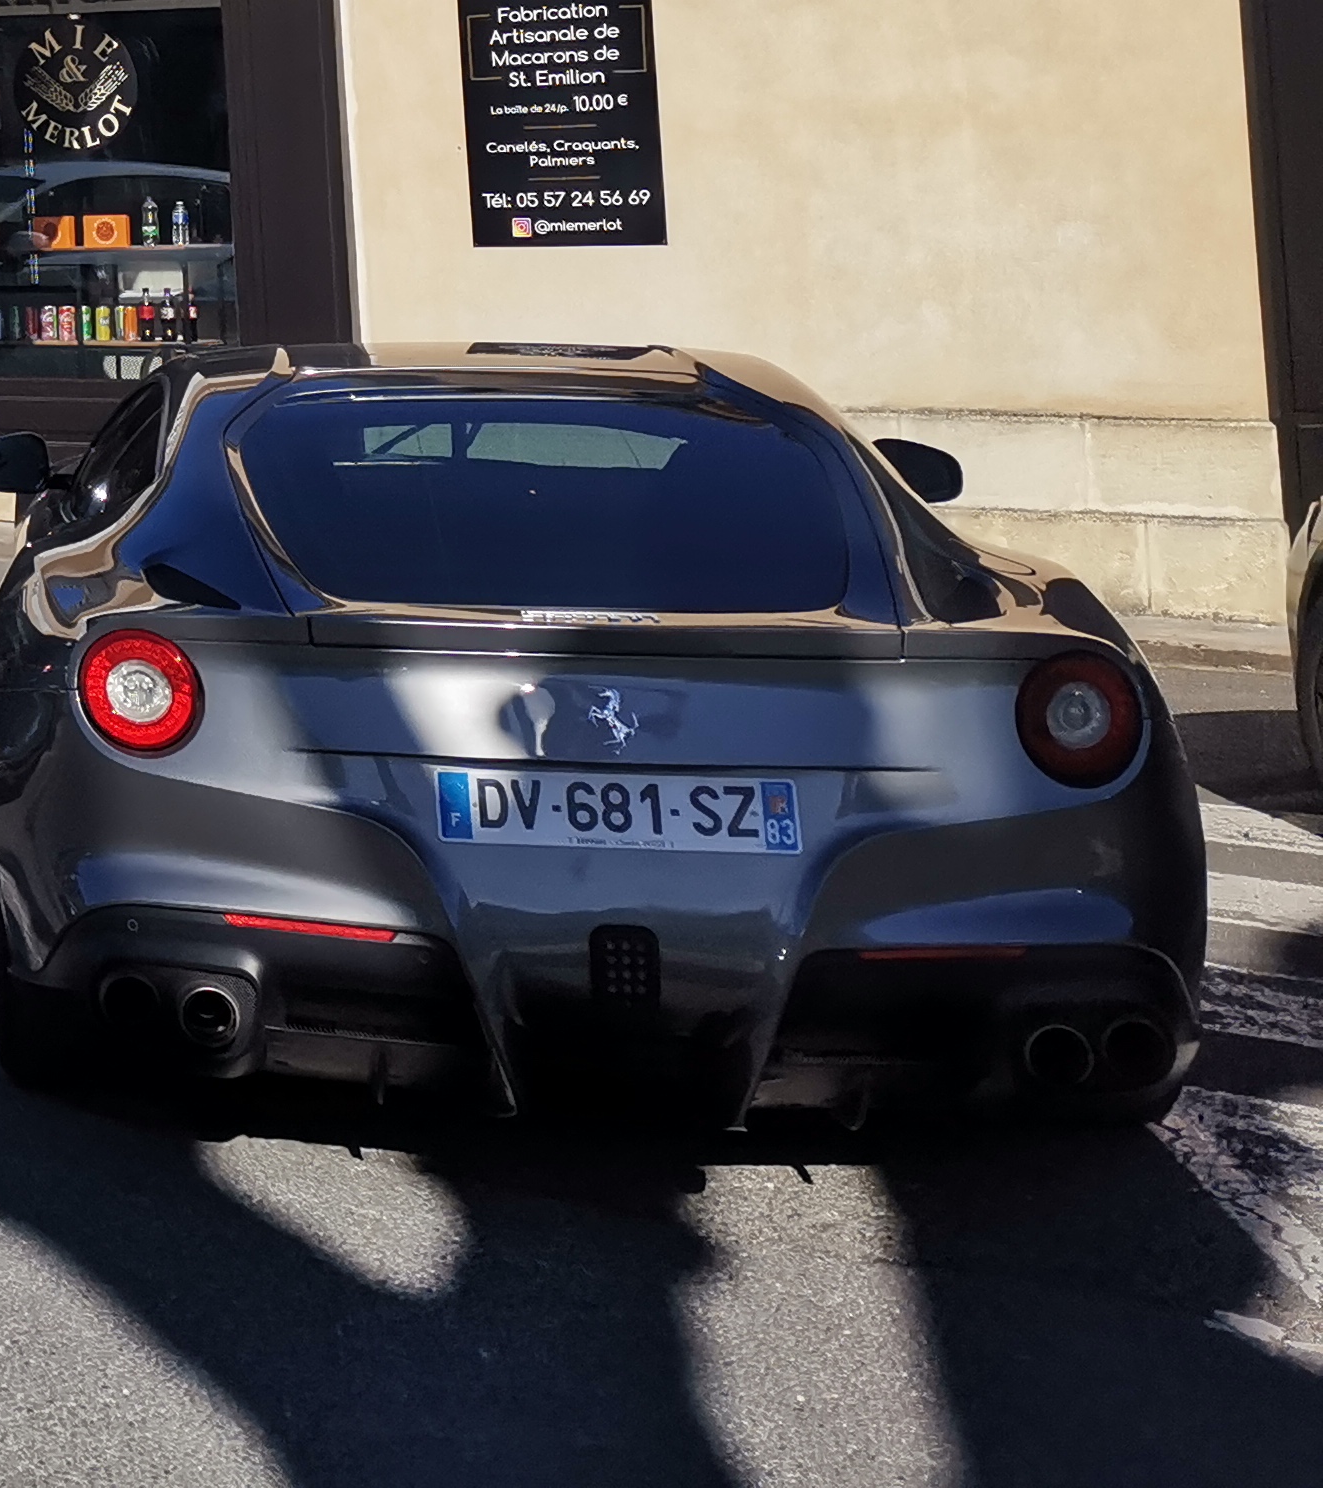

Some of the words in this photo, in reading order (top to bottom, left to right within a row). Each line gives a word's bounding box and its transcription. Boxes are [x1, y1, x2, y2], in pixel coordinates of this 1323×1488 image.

[497, 3, 608, 24] Fabrication
[28, 24, 119, 66] MIE
[489, 25, 589, 46] Artisanale
[594, 24, 620, 39] de
[491, 49, 589, 67] Macarons
[594, 45, 620, 61] de
[59, 55, 88, 83] &
[509, 72, 531, 87] St.
[536, 69, 605, 87] Emilion
[490, 105, 503, 115] La
[530, 104, 543, 113] de
[573, 94, 614, 112] 10.00
[617, 93, 629, 106] €
[21, 95, 133, 150] MERLOT
[486, 140, 551, 153] Canelés,
[553, 137, 640, 154] Craquants,
[529, 155, 596, 167] Palmiers
[482, 192, 512, 209] Tél:
[516, 192, 539, 208] 05
[544, 191, 566, 207] 57
[570, 191, 595, 207] 24
[600, 190, 623, 206] 56
[628, 189, 651, 206] 69
[534, 218, 623, 235] @miemerlot
[476, 778, 760, 839] DV-681-SZ
[450, 812, 461, 828] F
[766, 818, 795, 846] 83
